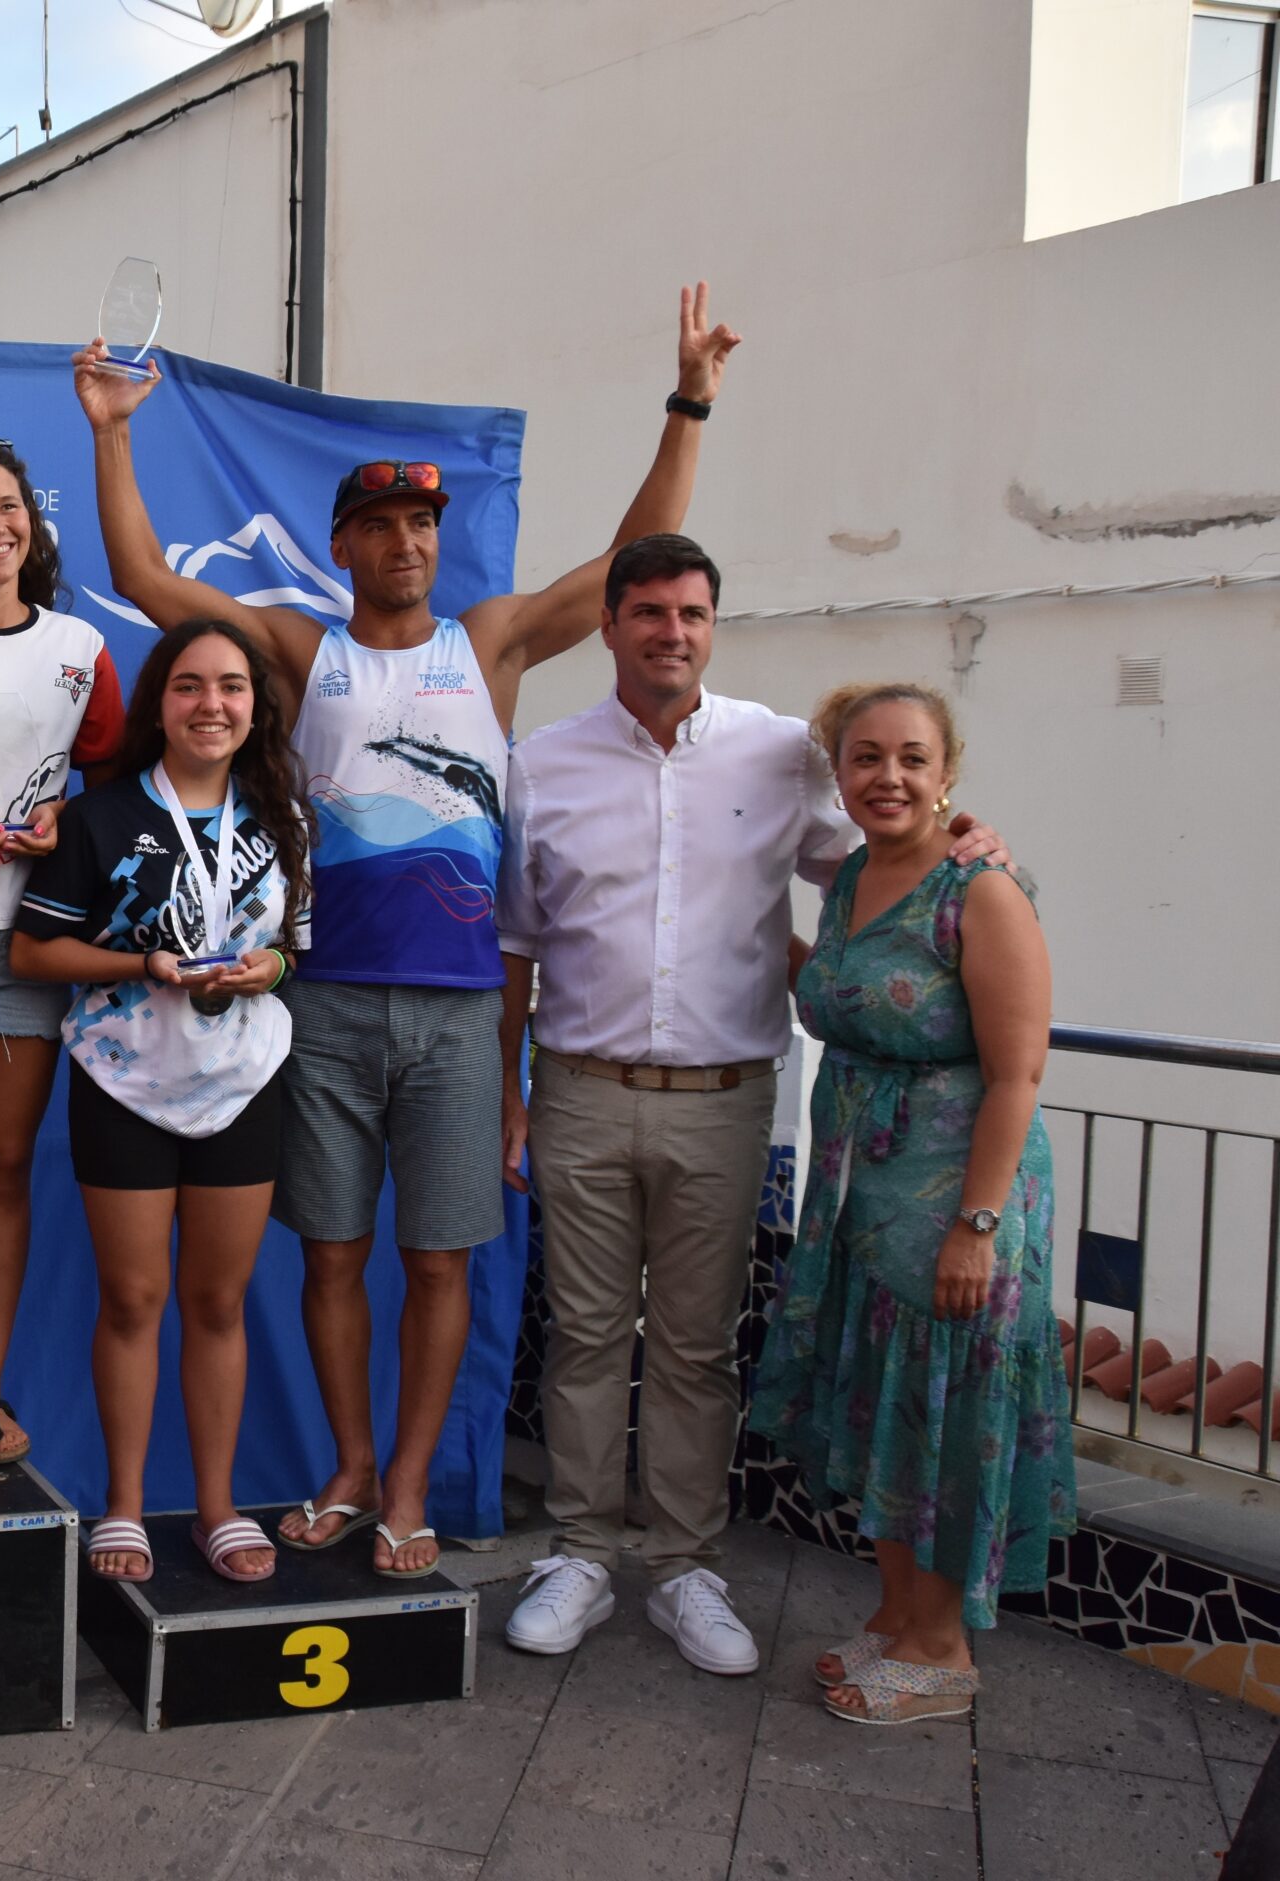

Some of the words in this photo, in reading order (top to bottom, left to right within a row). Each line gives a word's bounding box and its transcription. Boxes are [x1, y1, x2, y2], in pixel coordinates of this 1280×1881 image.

[318, 680, 351, 689] SANTIAGO
[423, 681, 431, 689] A
[322, 687, 351, 698] TEIDE
[20, 1516, 45, 1526] CAM
[279, 1625, 350, 1707] 3
